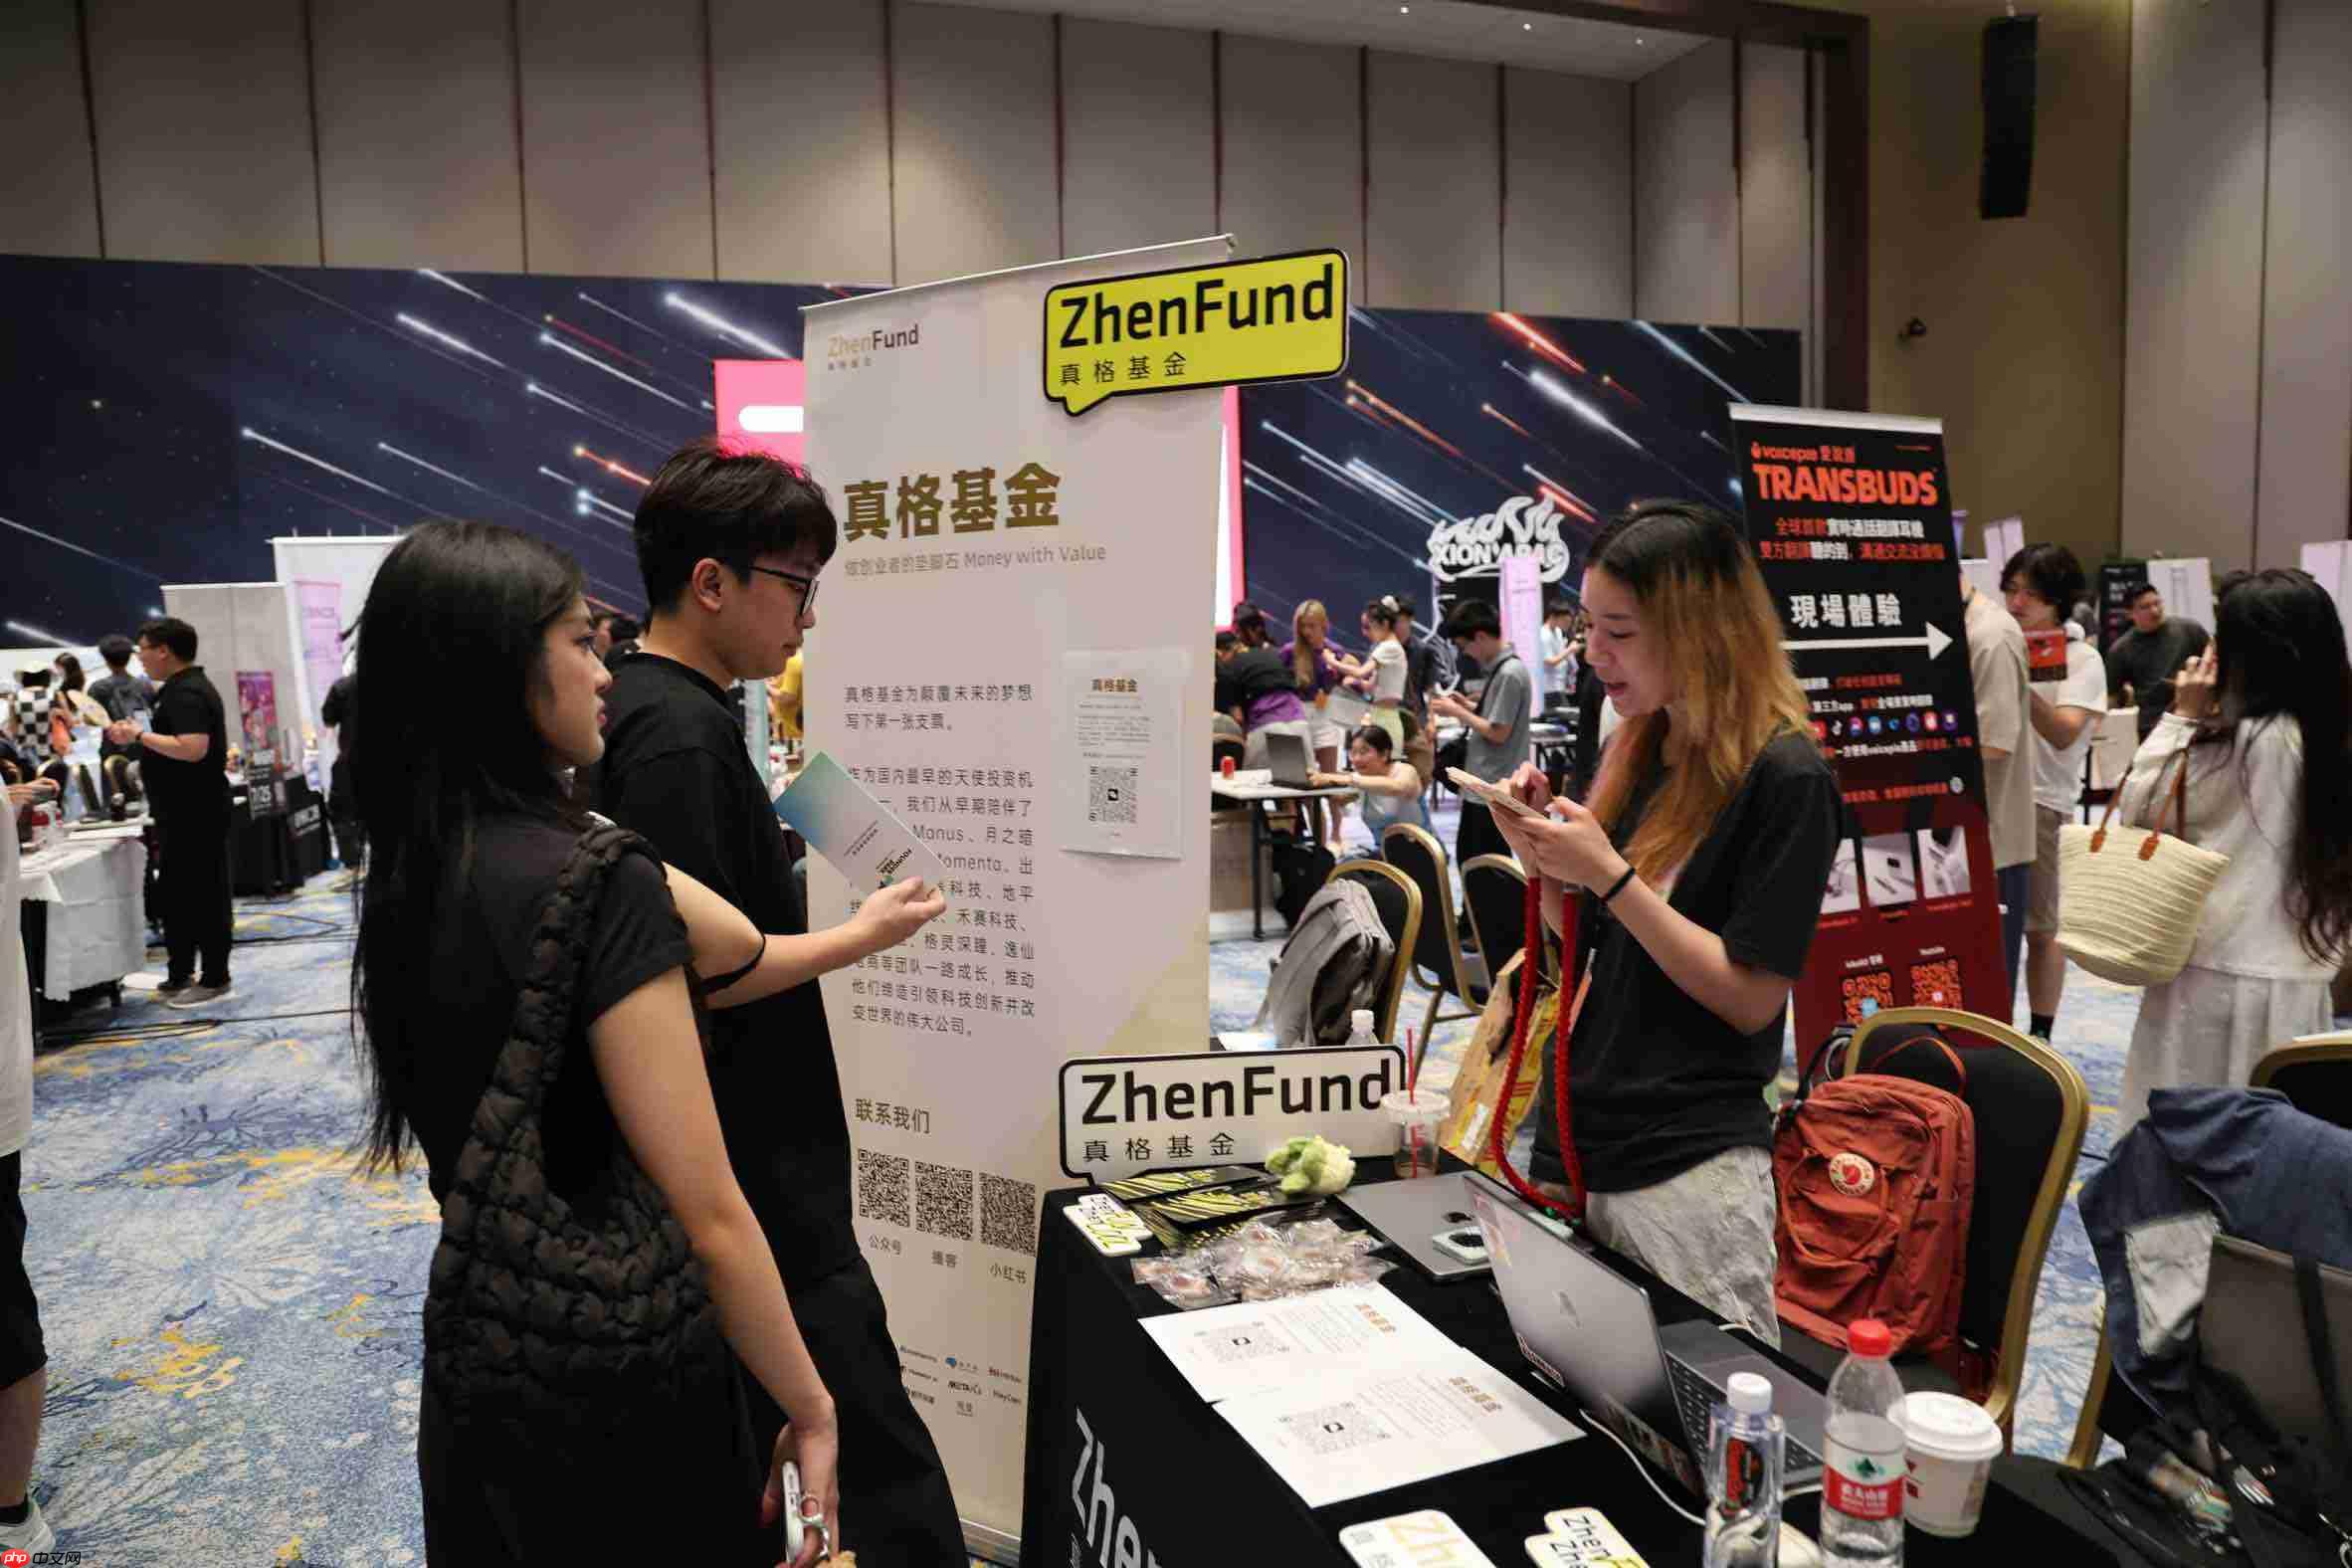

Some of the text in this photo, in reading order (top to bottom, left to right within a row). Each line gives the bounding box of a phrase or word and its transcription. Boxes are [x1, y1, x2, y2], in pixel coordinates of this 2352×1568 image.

[1060, 263, 1335, 349] ZhenFund
[828, 323, 920, 357] ZhenFund
[1061, 352, 1188, 387] 真格基金
[844, 462, 1061, 542] 真格基金
[1752, 464, 1938, 506] TRANSBUDS
[963, 550, 1013, 569] Money
[1016, 547, 1055, 565] with
[1059, 544, 1107, 562] Value
[1789, 593, 1902, 629] 現場體驗
[1081, 1059, 1391, 1125] ZhenFund
[856, 1097, 931, 1134] 联系我们
[1082, 1131, 1236, 1163] 真格基金
[868, 1234, 902, 1255] 公众号
[990, 1264, 1027, 1283] 小红书
